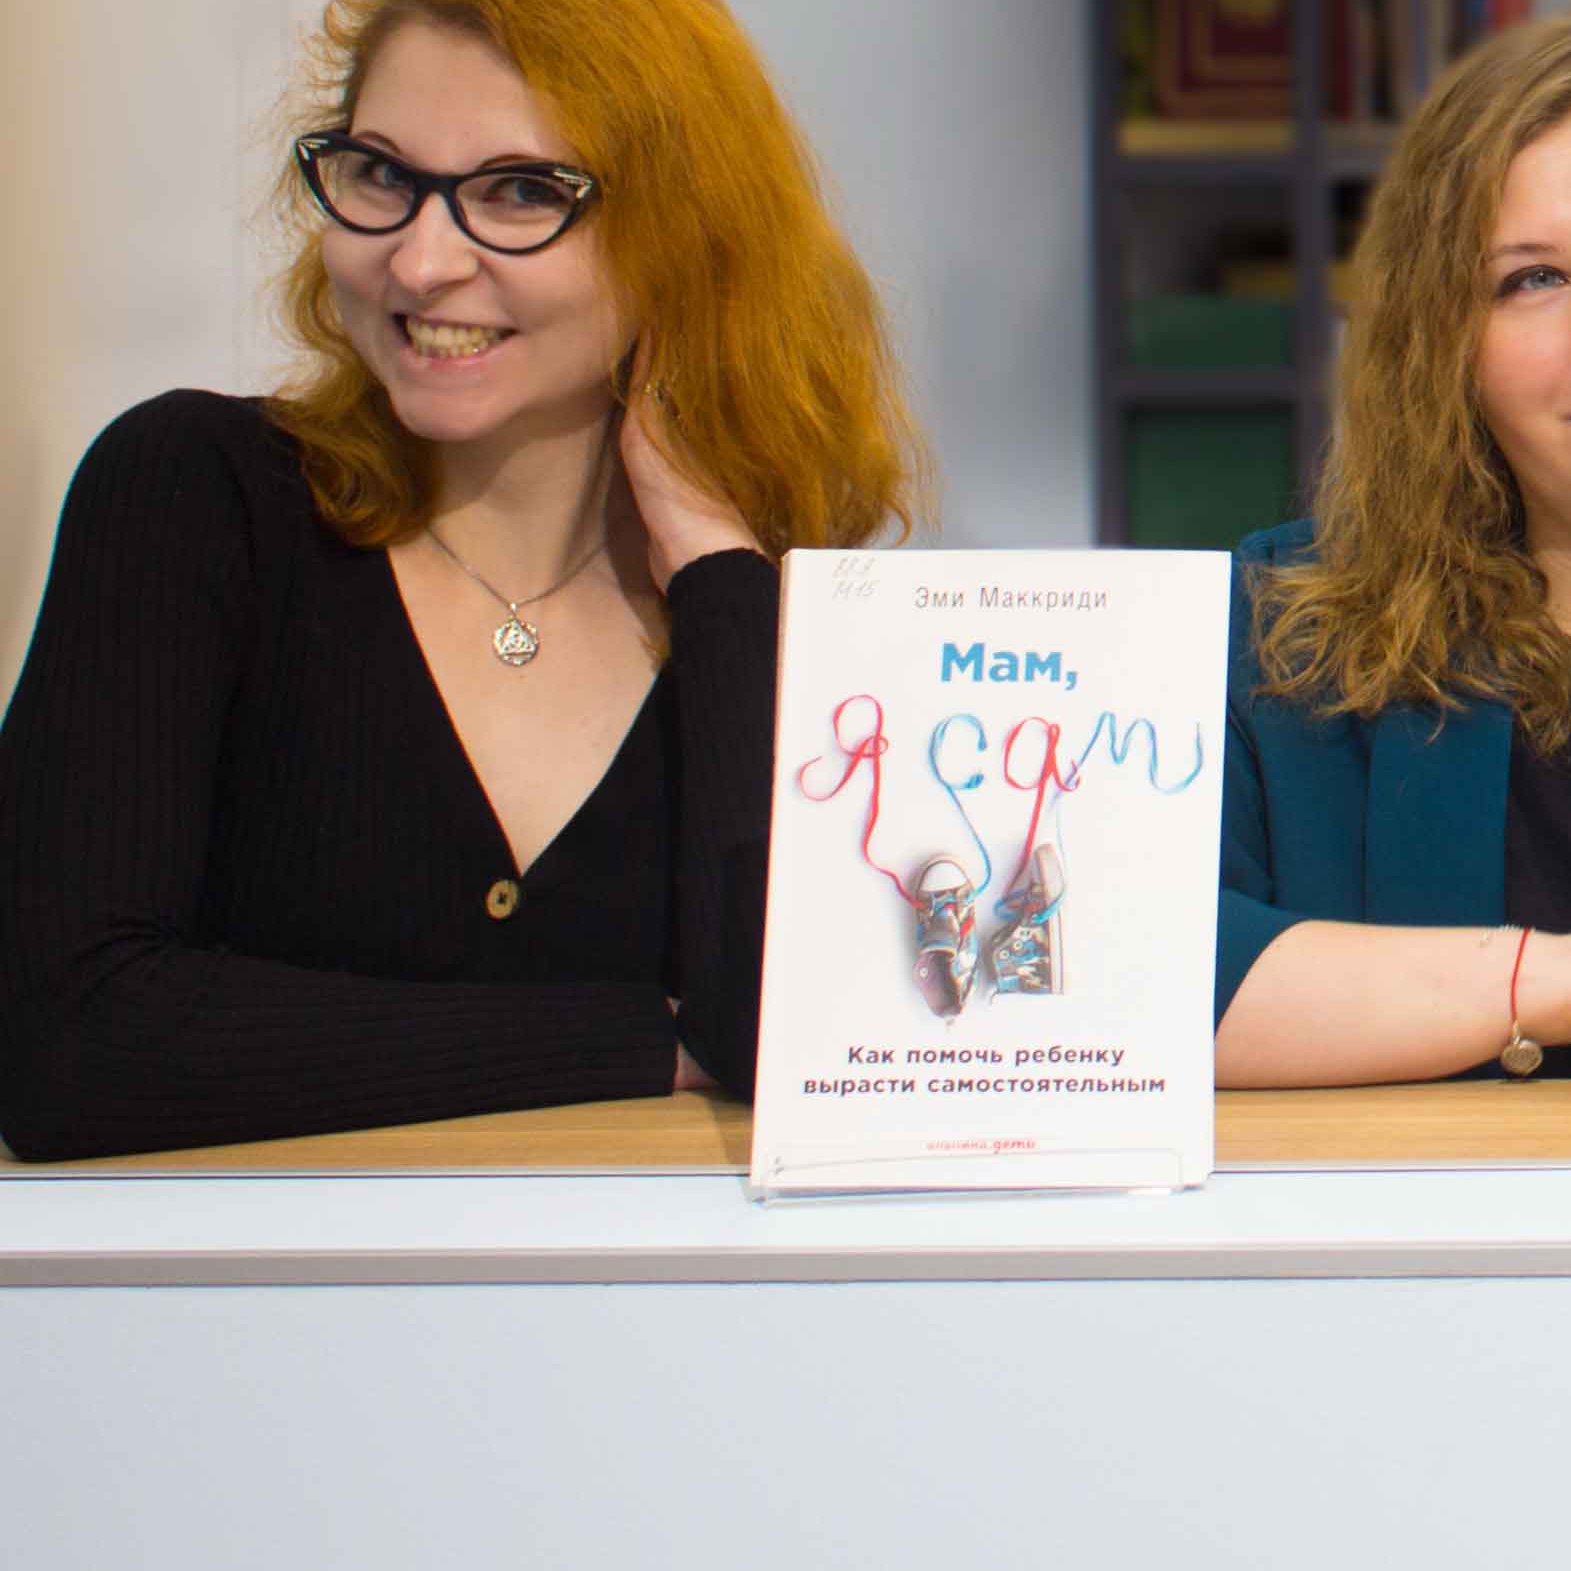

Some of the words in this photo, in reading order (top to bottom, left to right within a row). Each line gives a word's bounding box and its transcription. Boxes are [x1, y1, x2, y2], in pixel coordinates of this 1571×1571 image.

[913, 586, 964, 609] Эми
[979, 586, 1107, 612] Маккриди
[940, 641, 1078, 692] Мам,
[848, 1046, 896, 1065] Как
[906, 1050, 1004, 1065] помочь
[1014, 1045, 1126, 1067] ребенку
[803, 1077, 917, 1097] вырасти
[927, 1077, 1166, 1094] самостоятельным
